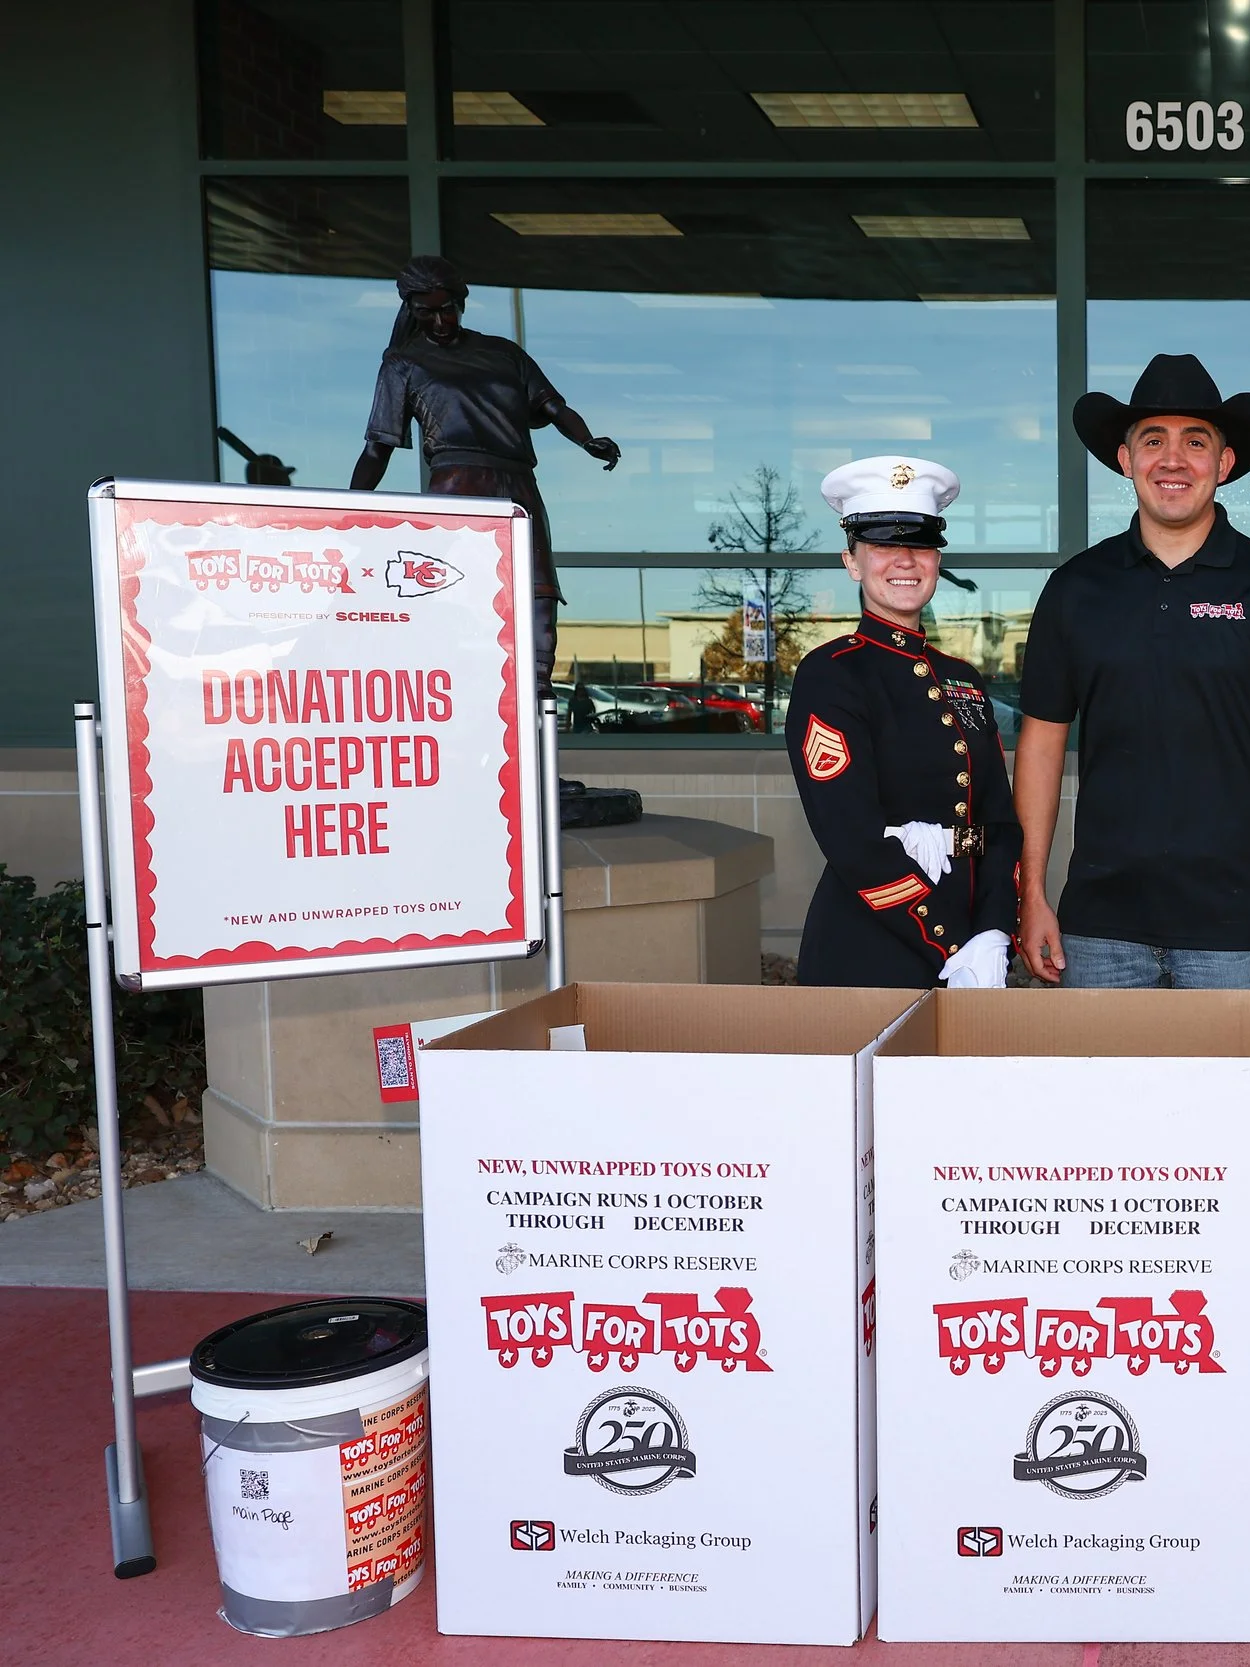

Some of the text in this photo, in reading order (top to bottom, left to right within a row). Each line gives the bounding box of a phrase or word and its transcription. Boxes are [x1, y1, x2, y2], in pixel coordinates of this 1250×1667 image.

[1126, 101, 1244, 150] 6503
[190, 556, 238, 576] TOYS
[250, 560, 284, 581] FOR
[295, 564, 341, 584] TOTS
[336, 612, 410, 622] SCHEELS
[203, 670, 453, 725] DONATIONS
[223, 735, 439, 793] ACCEPTED
[285, 802, 390, 858] HERE
[269, 912, 297, 923] AND
[302, 906, 389, 920] UNWRAPPED
[393, 904, 425, 914] TOYS
[429, 901, 462, 911] ONLY
[477, 1159, 770, 1179] NEW, UNWRAPPED TOYS ONLY
[933, 1166, 1227, 1182] NEW, UNWRAPPED TOYS ONLY
[486, 1190, 763, 1210] CAMPAIGN RUNS 1 OCTOBER
[941, 1198, 1219, 1213] CAMPAIGN RUNS 1 OCTOBER
[506, 1214, 745, 1232] THROUGH DECEMBER
[961, 1220, 1201, 1235] THROUGH DECEMBER
[528, 1253, 757, 1271] MARINE CORPS RESERVE
[982, 1260, 1212, 1274] MARINE CORPS RESERVE
[490, 1303, 748, 1354] TOYS FOR TOTS
[942, 1310, 1201, 1355] TOYS FOR TOTS
[381, 1404, 404, 1420] CORPS
[341, 1415, 423, 1460] TOYS FOR TOTS
[599, 1420, 673, 1453] 250
[1049, 1425, 1124, 1458] 250
[605, 1457, 631, 1466] STATES
[633, 1454, 661, 1462] MARINE
[351, 1465, 409, 1497] MARINE CORPS
[350, 1493, 406, 1524] TOYS FOR
[377, 1532, 400, 1548] CORPS
[560, 1529, 752, 1551] Welch Packaging Group
[1008, 1534, 1200, 1552] Welch Packaging Group
[376, 1559, 397, 1575] FOR
[403, 1538, 420, 1559] TOTS
[566, 1571, 698, 1582] MAKING A DIFFERENCE
[1013, 1576, 1147, 1584] MAKING A DIFFERENCE
[603, 1583, 655, 1591] COMMUNITY
